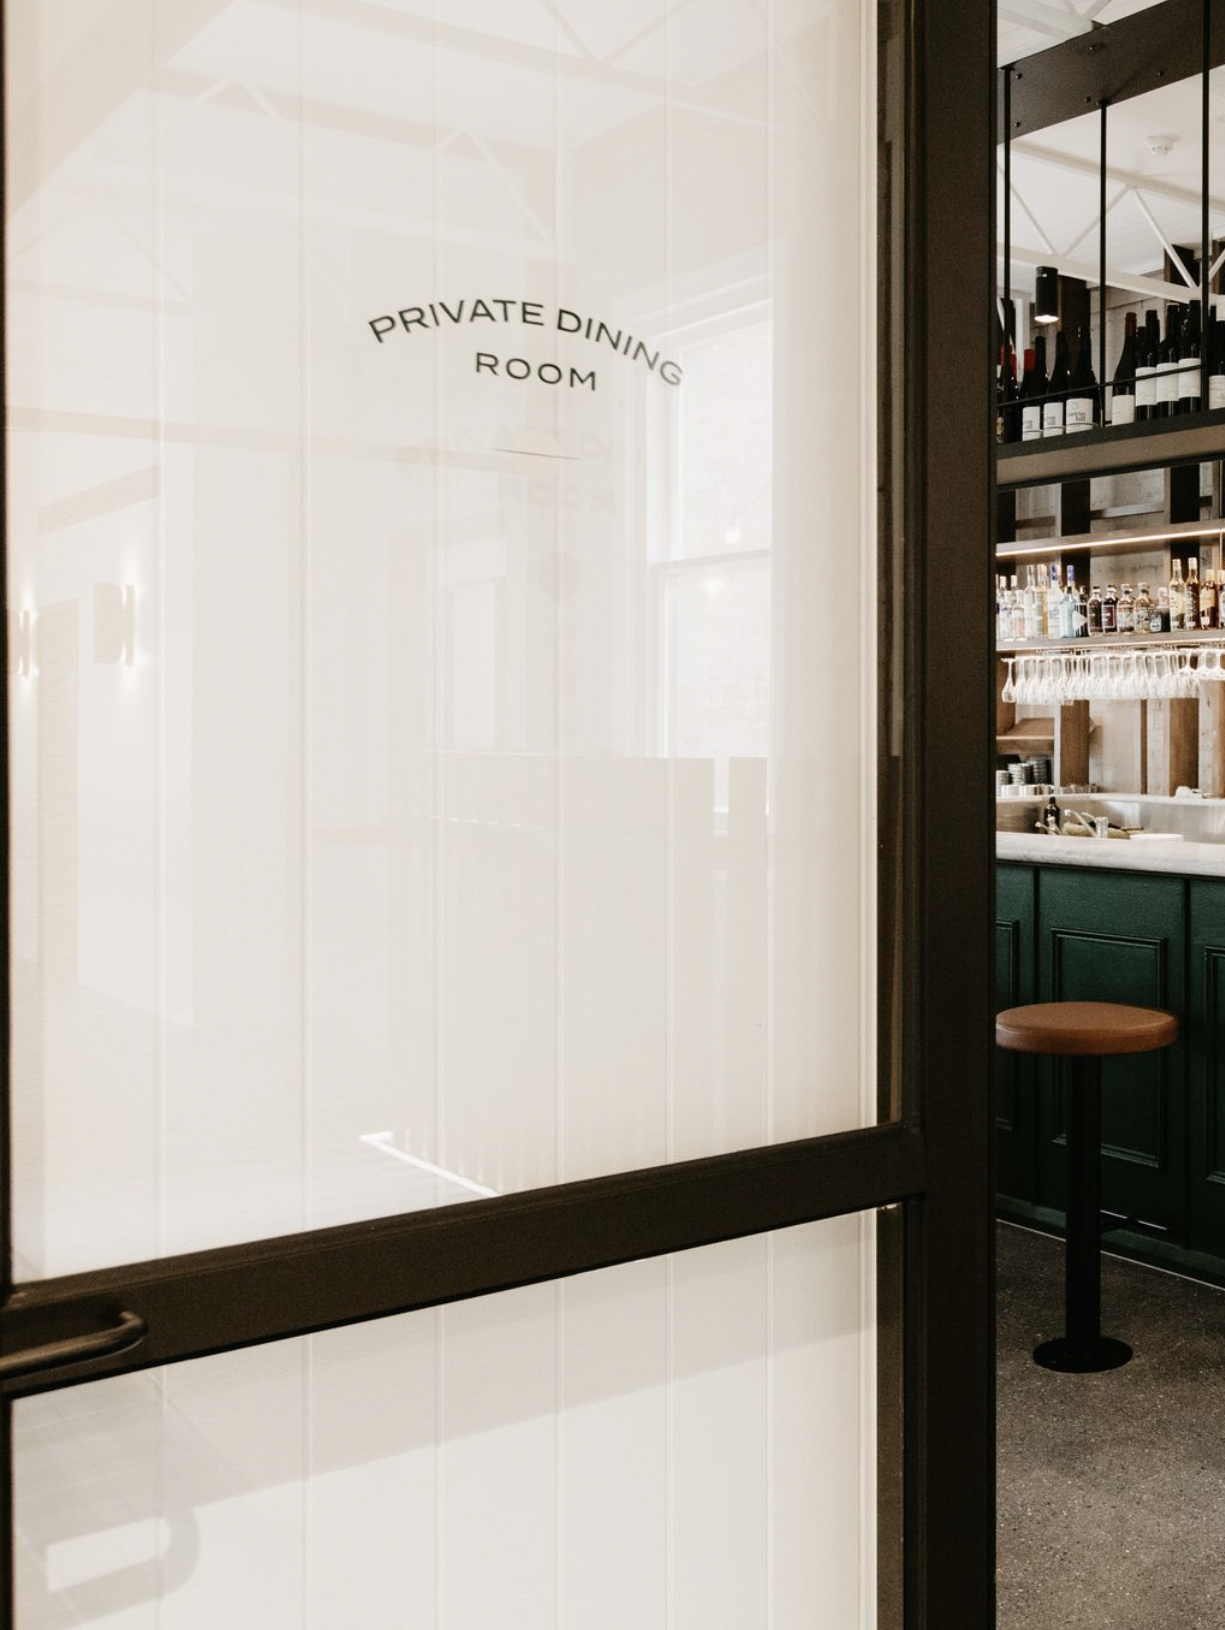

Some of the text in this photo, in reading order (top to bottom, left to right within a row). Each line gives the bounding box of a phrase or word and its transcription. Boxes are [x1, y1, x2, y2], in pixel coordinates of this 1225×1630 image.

[368, 299, 683, 386] PRIVATE DINING
[476, 352, 596, 391] ROOM
